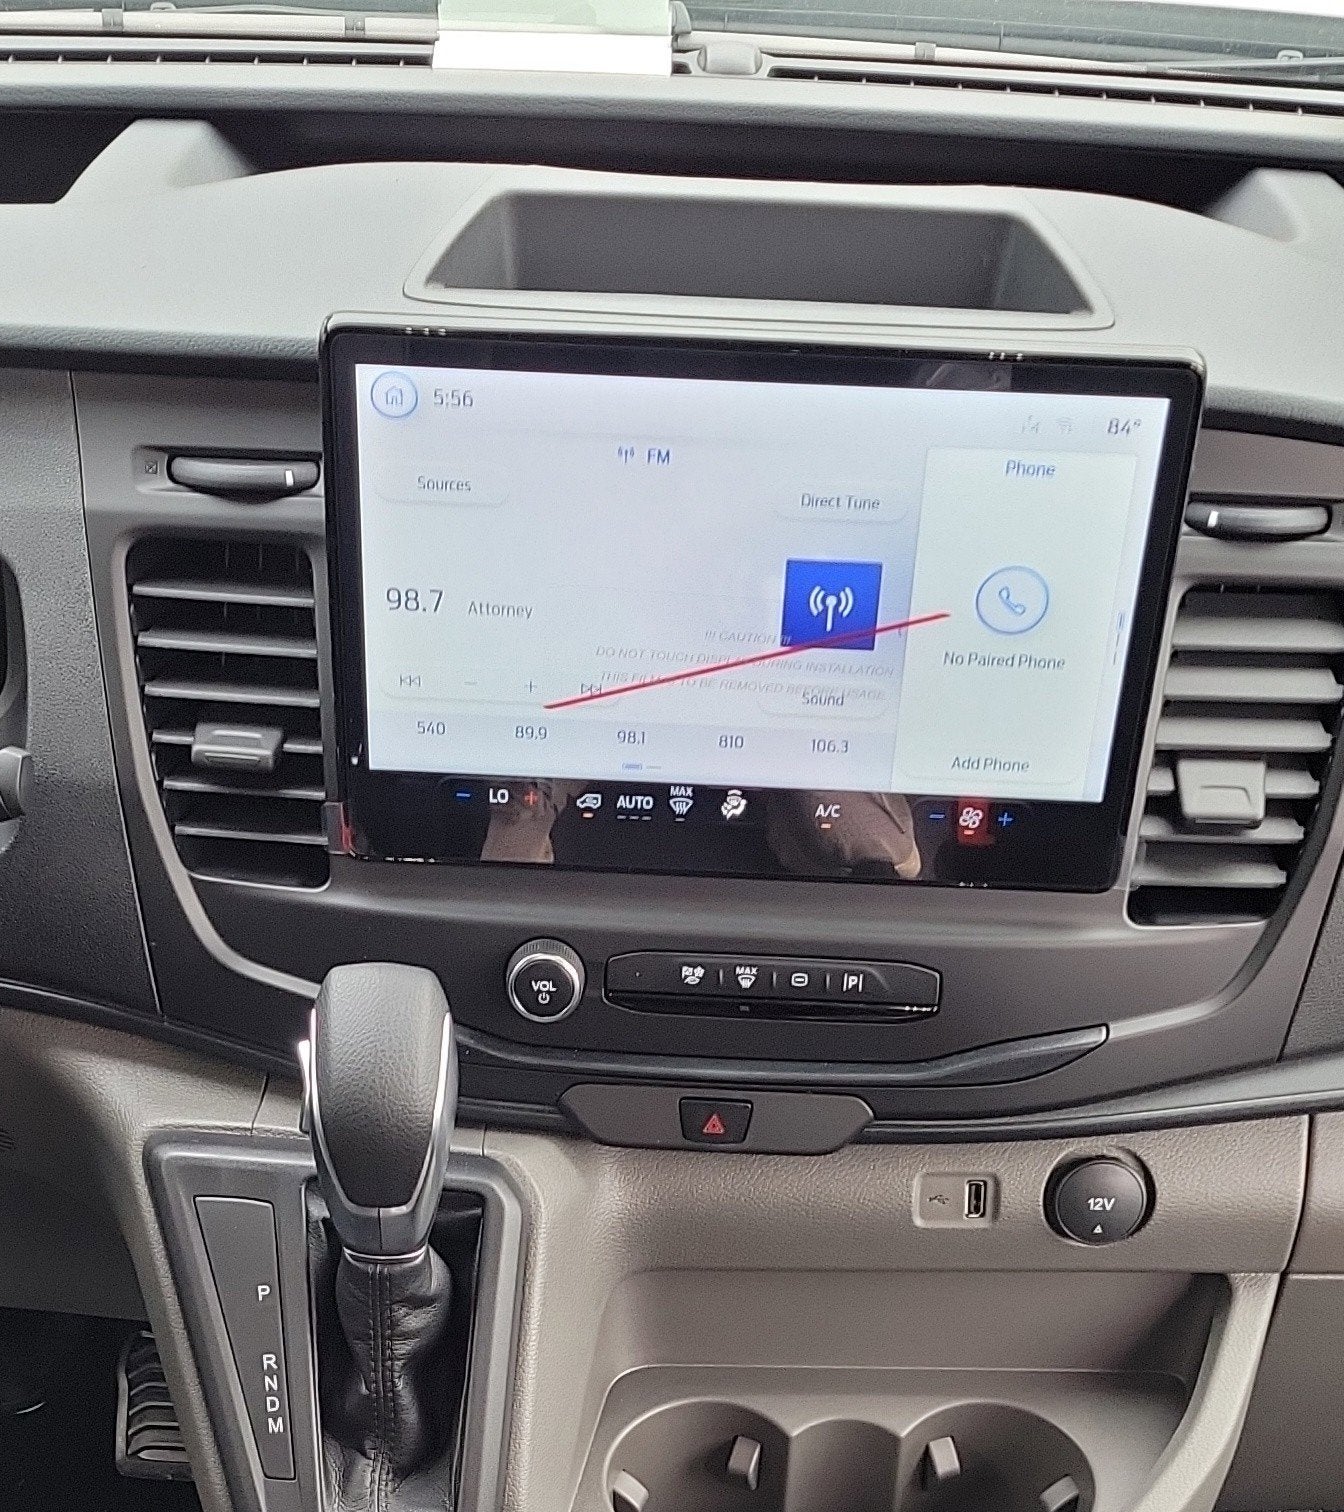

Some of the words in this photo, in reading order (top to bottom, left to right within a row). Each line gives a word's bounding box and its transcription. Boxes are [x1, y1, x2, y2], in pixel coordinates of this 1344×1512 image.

[433, 388, 474, 408] 5:56
[646, 448, 671, 465] FM
[1005, 460, 1056, 478] Phone
[417, 475, 472, 492] Sources
[801, 493, 841, 510] Direct
[846, 494, 881, 511] Tune
[386, 587, 444, 613] 98.7
[468, 601, 533, 620] Attorney
[719, 631, 776, 645] CAUTION
[596, 645, 616, 657] DO
[619, 647, 647, 660] NOT
[650, 649, 694, 663] TOUCH
[697, 652, 753, 667] DISPL
[806, 661, 894, 677] INSTALLATION
[943, 651, 965, 666] No
[967, 652, 1015, 668] Paired
[1017, 654, 1066, 670] Phone
[719, 679, 783, 693] REMOVED
[802, 690, 844, 706] Sound
[417, 720, 446, 736] 540
[515, 725, 548, 741] 89.9
[617, 729, 646, 745] 98.1
[718, 735, 744, 750] 810
[811, 739, 849, 754] 106.3
[951, 756, 980, 771] Add
[983, 757, 1030, 773] Phone
[489, 787, 509, 804] LO
[616, 794, 654, 810] AUTO
[670, 785, 693, 798] MAX
[815, 803, 841, 819] A/C
[735, 966, 758, 975] MAX
[531, 980, 557, 993] VOL
[1087, 1196, 1116, 1211] 12V
[257, 1285, 271, 1301] P
[262, 1354, 278, 1370] R
[264, 1375, 278, 1390] N
[266, 1396, 280, 1412] D
[268, 1418, 284, 1433] M
